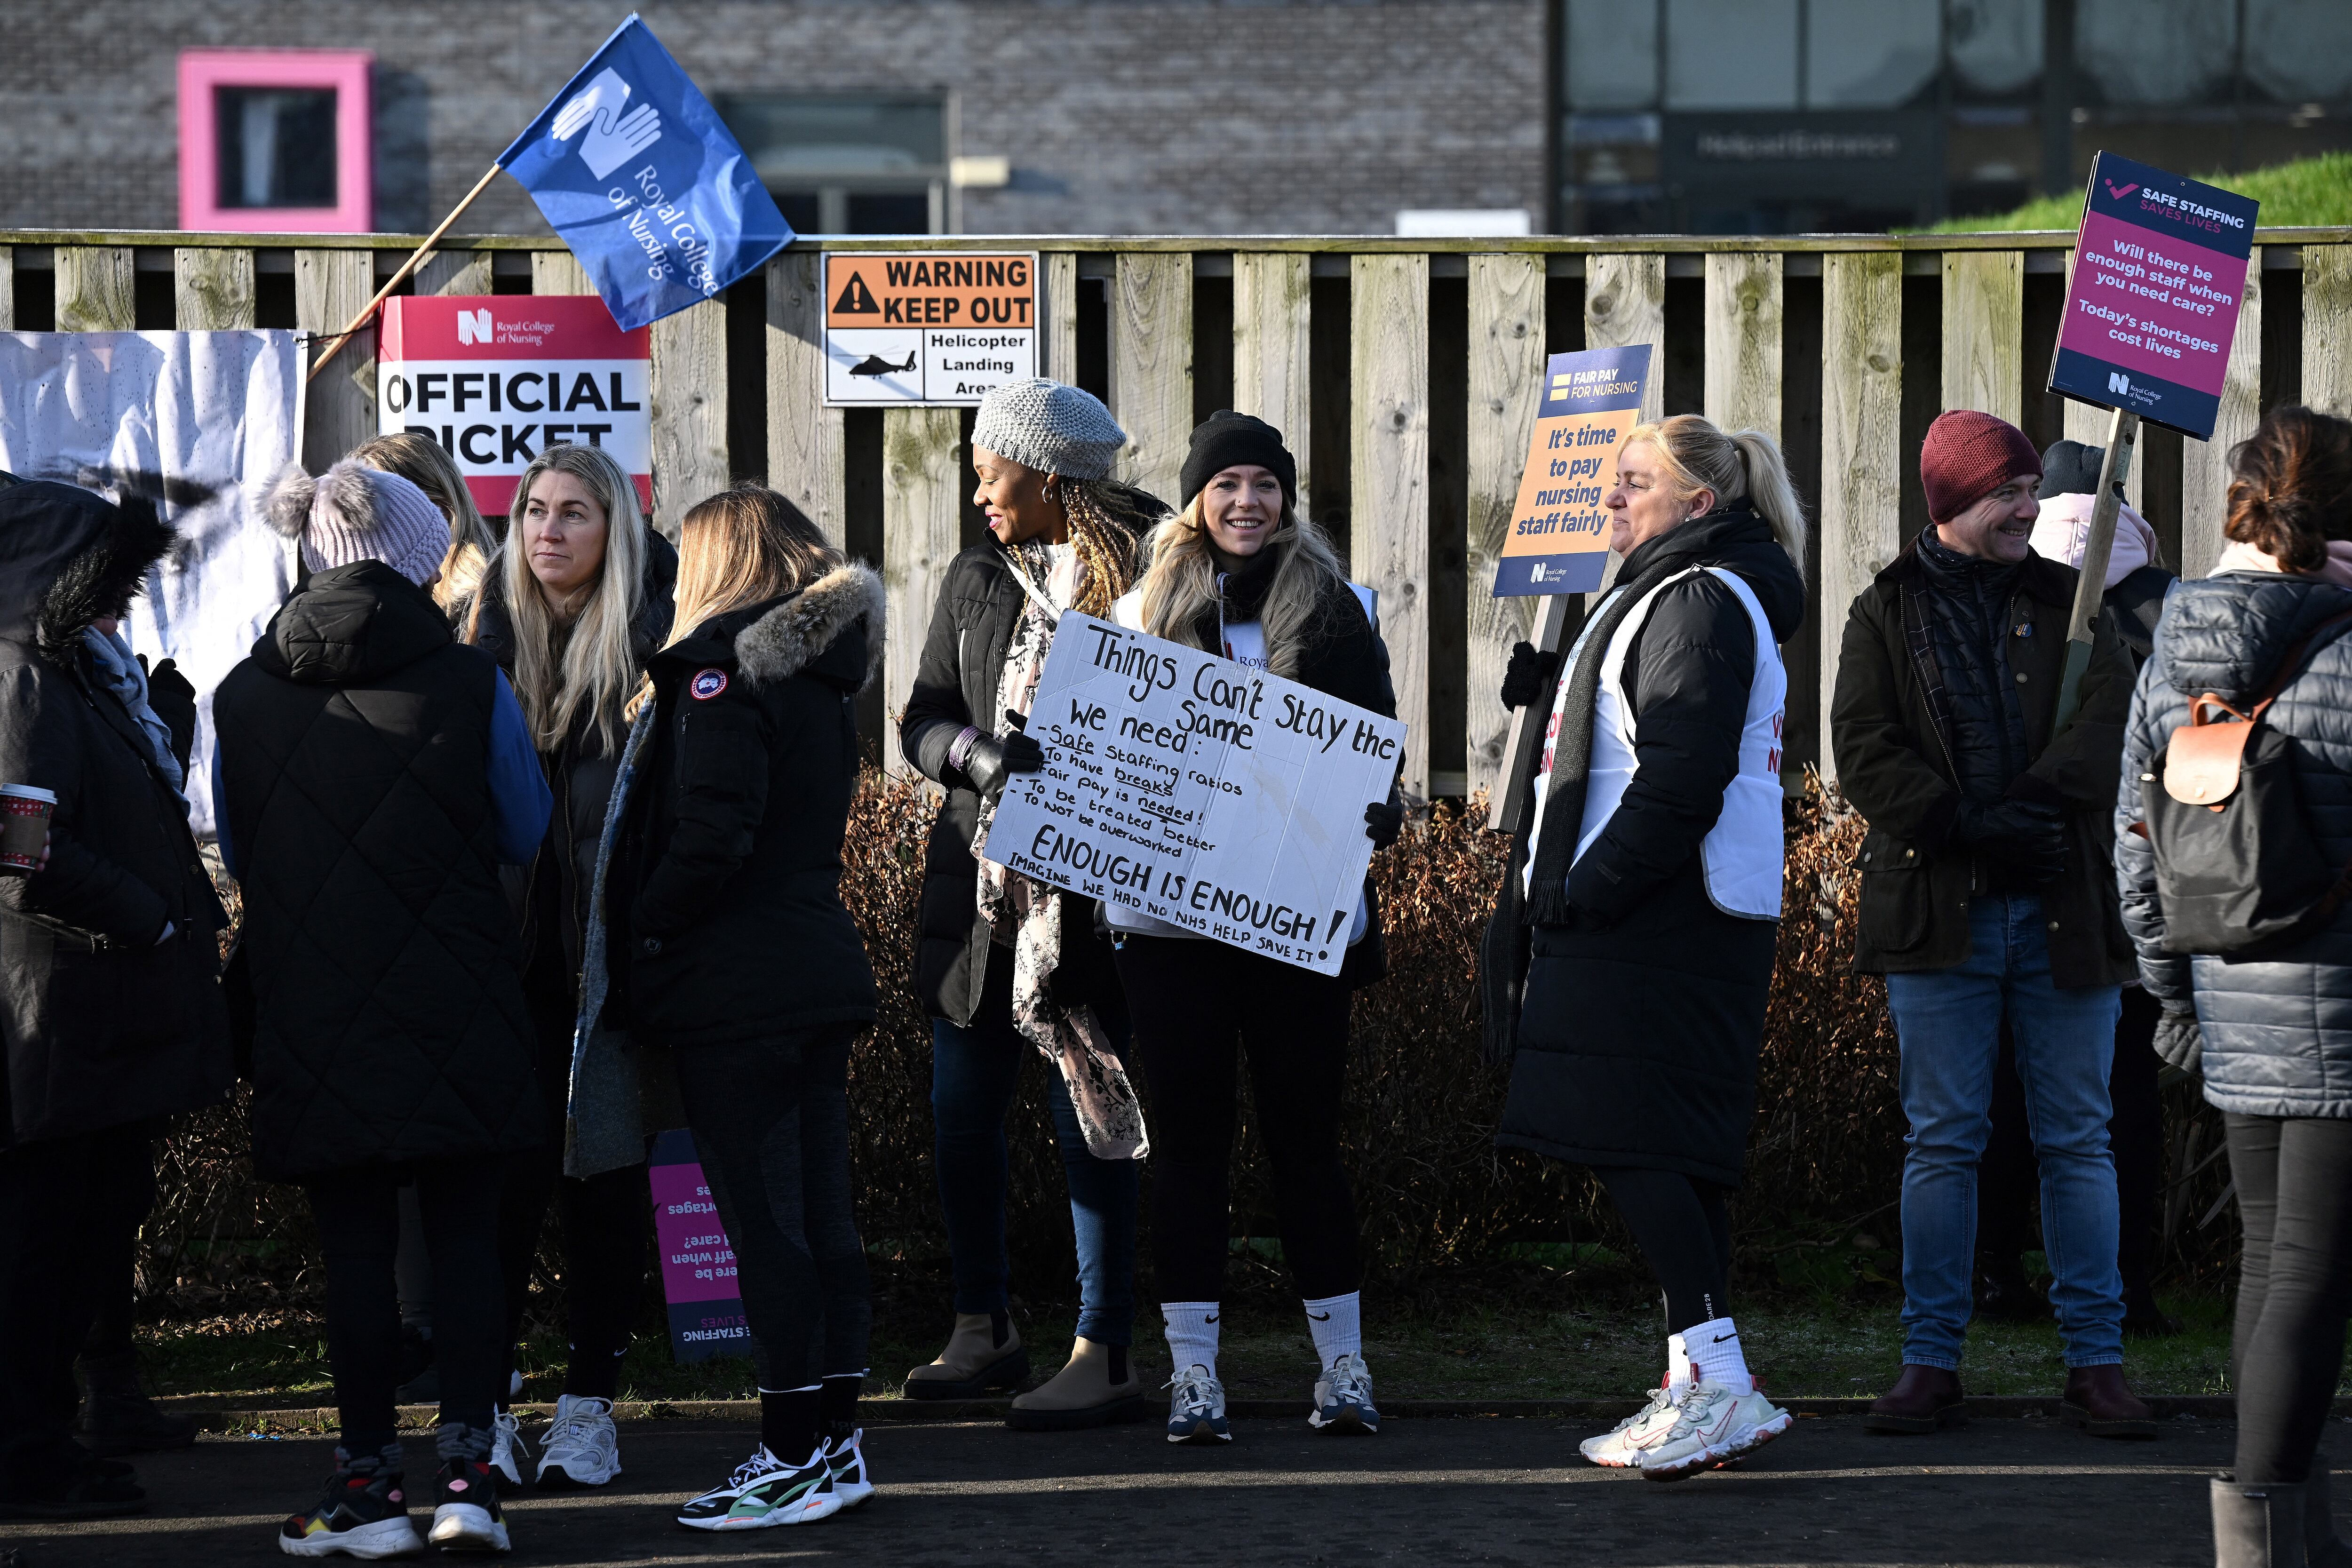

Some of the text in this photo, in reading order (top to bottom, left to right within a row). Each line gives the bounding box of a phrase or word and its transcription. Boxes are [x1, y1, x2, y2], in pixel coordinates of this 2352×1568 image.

[2139, 199, 2221, 234] SAVES LIVES
[2142, 188, 2245, 229] SAFE STAFFING
[608, 187, 675, 281] of Nursing
[634, 164, 719, 297] Royal College
[885, 261, 1027, 287] WARNING
[2114, 239, 2213, 282] Will there be
[2086, 251, 2233, 306] enough staff when
[2095, 271, 2216, 317] you need care?
[884, 297, 1031, 323] KEEP OUT
[497, 321, 555, 334] Royal College
[497, 333, 542, 347] of Nursing
[2078, 299, 2219, 354] Today's shortages
[931, 334, 1026, 350] Helicopter
[2108, 327, 2182, 359] cost lives
[943, 358, 1014, 374] Landing
[1573, 368, 1619, 385] FAIR PAY
[387, 372, 640, 414] OFFICIAL
[1571, 380, 1638, 399] FOR NURSING
[2130, 385, 2162, 401] Royal College
[2135, 393, 2153, 406] Nursing
[1548, 423, 1617, 450] It's time
[1549, 457, 1603, 481] to pay
[1535, 481, 1602, 508] nursing
[1516, 509, 1608, 536] staff fairly
[1240, 656, 1269, 669] Roya
[1088, 624, 1396, 760] Things Can't Stay the
[1176, 700, 1253, 750] Same
[1038, 761, 1070, 781] Fair
[1116, 788, 1128, 802] is
[1045, 747, 1173, 796] To have breaks
[1104, 745, 1179, 787] Staffing
[1188, 770, 1242, 796] ratios
[1029, 779, 1045, 794] To
[1056, 788, 1076, 804] be
[1089, 799, 1152, 831] treated
[1164, 826, 1216, 852] better
[1044, 801, 1074, 818] NOT
[1079, 813, 1094, 827] be
[1099, 822, 1182, 858] overworked
[1031, 824, 1152, 892] ENOUGH
[1160, 871, 1186, 900] IS
[1008, 852, 1314, 963] IMAGINE WE HAD NO NHS HELP SAVE IT
[668, 1202, 717, 1215] rtages
[684, 1234, 721, 1249] care?
[672, 1251, 734, 1265] aff when
[695, 1267, 738, 1280] ere be
[1704, 1294, 1714, 1320] DARE2B
[683, 1327, 744, 1342] STAFFING
[701, 1316, 734, 1328] LIVES
